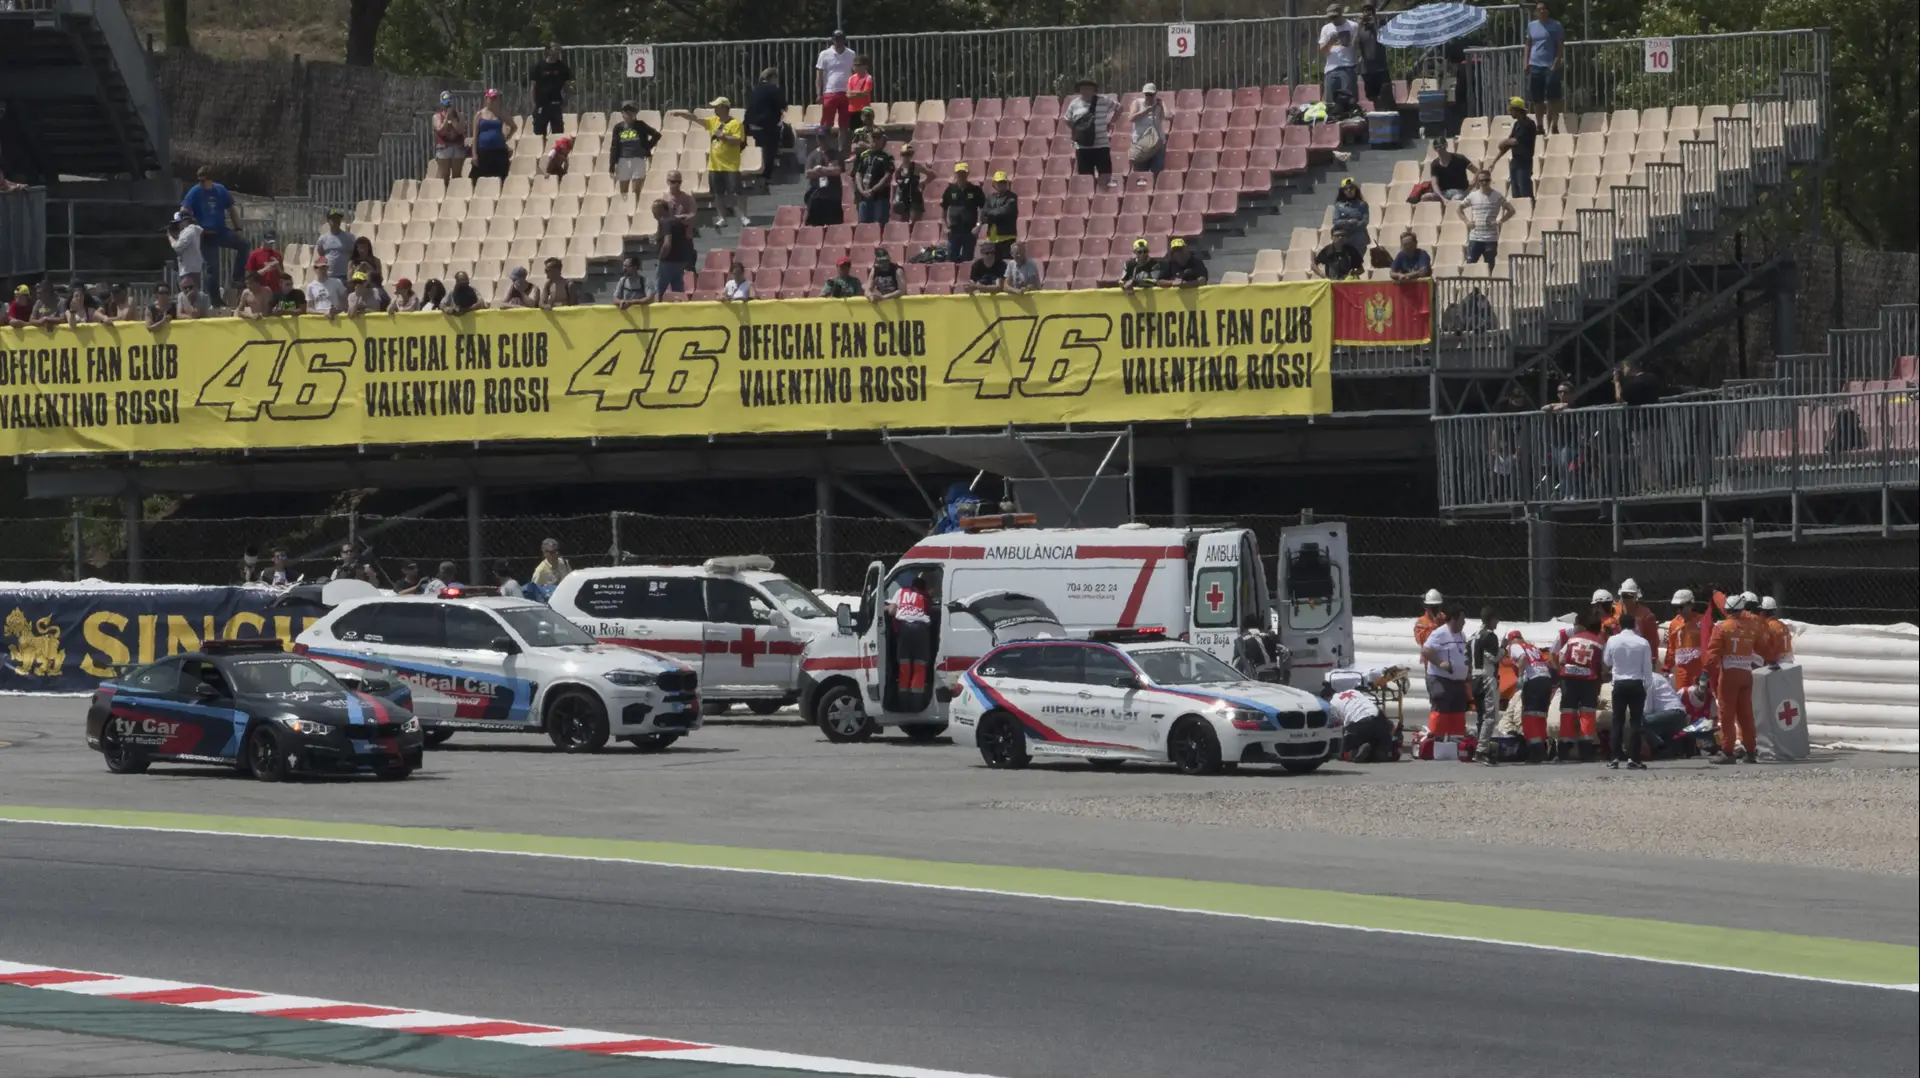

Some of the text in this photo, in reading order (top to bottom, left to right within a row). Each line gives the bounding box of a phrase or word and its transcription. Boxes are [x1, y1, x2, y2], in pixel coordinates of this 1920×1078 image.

[1171, 27, 1192, 35] ZONA
[1177, 36, 1188, 54] 9
[635, 57, 646, 74] 8
[1650, 50, 1669, 69] 10
[738, 319, 926, 361] OFFICIAL FAN CLUB
[1120, 305, 1313, 350] OFFICIAL FAN CLUB
[0, 343, 179, 386] OFFICIAL FAN CLUB
[364, 331, 549, 373] OFFICIAL FAN CLUB
[565, 325, 731, 412] 46
[943, 313, 1113, 400] 46
[194, 337, 358, 422] 46
[739, 364, 928, 408] VALENTINO ROSSI
[1121, 352, 1313, 395] VALENTINO ROSSI
[0, 388, 180, 430] VALENTINO ROSSI
[364, 375, 550, 418] VALENTINO ROSSI
[985, 543, 1074, 561] AMBULÀNCIA
[1205, 544, 1240, 562] AMBUL
[902, 591, 917, 604] M
[1066, 582, 1081, 592] 704
[1095, 583, 1106, 592] 22
[1108, 583, 1118, 592] 24
[599, 622, 625, 636] Roja
[379, 668, 500, 695] Medical Car
[142, 718, 180, 735] Car
